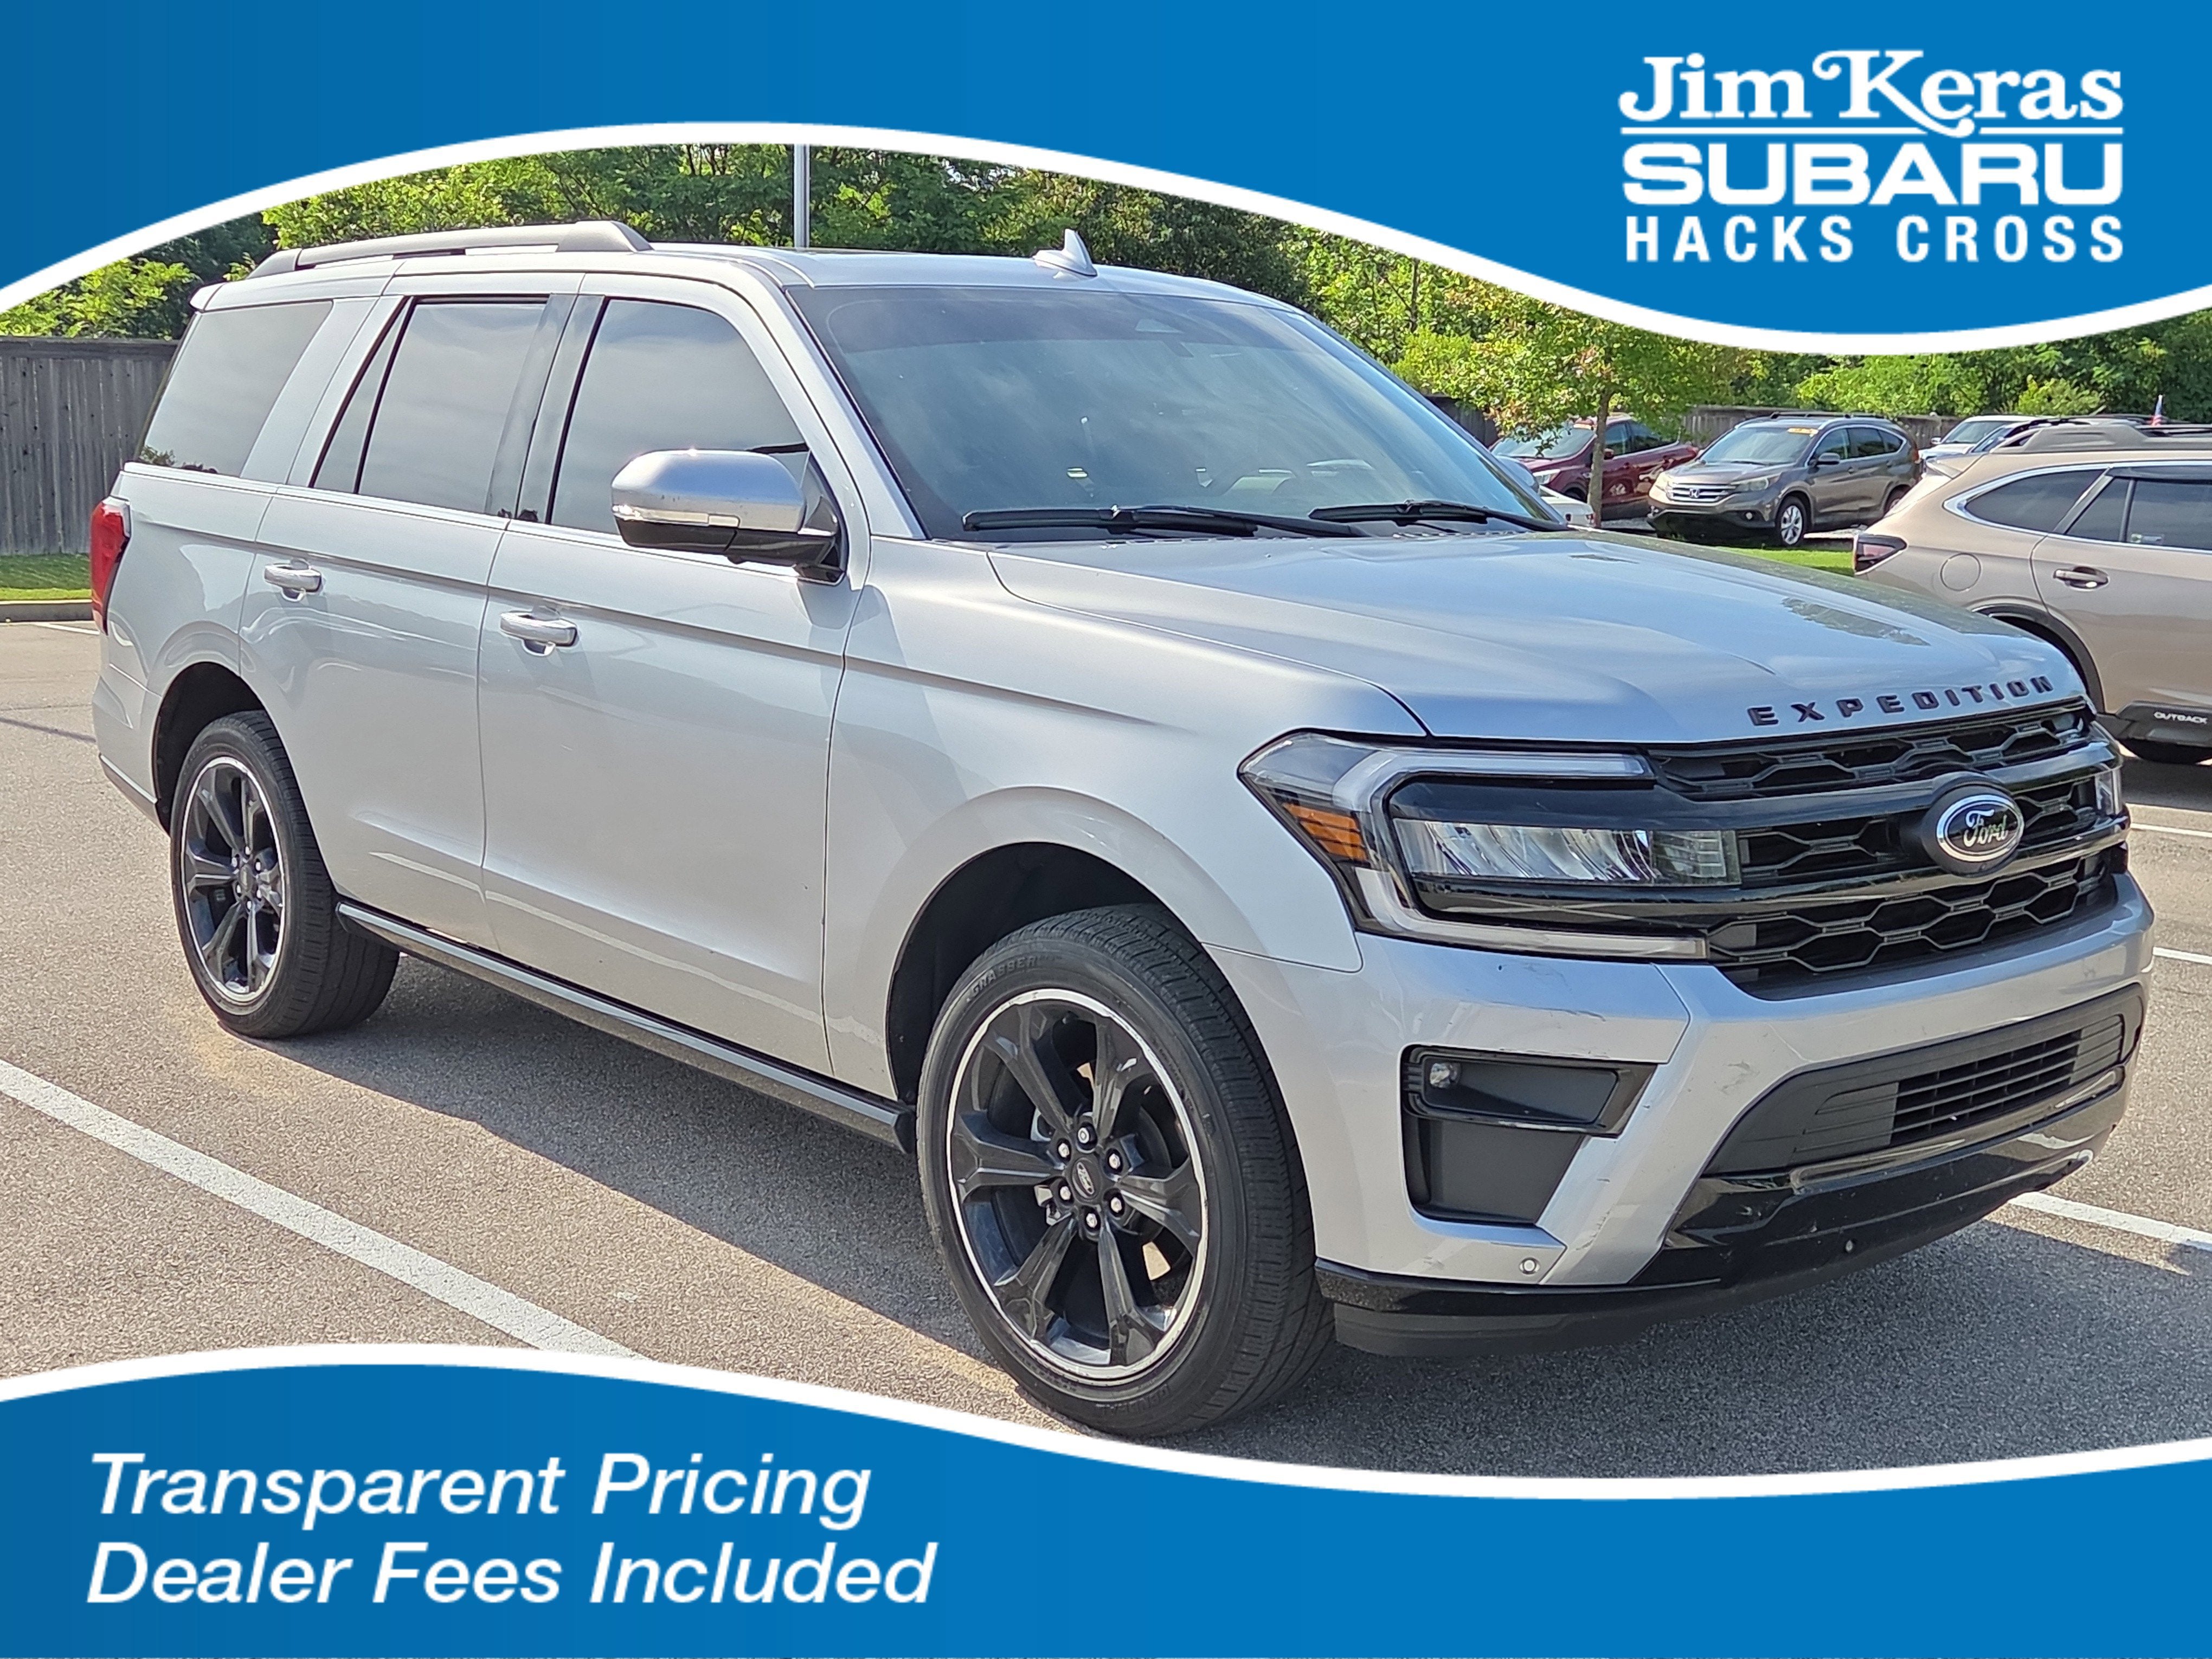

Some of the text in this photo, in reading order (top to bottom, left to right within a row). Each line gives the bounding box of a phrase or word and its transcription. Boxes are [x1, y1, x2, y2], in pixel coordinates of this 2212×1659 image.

[1747, 676, 2054, 726] EXPEDITION
[2153, 711, 2208, 724] OUTBACK
[1963, 809, 2009, 847] Ford
